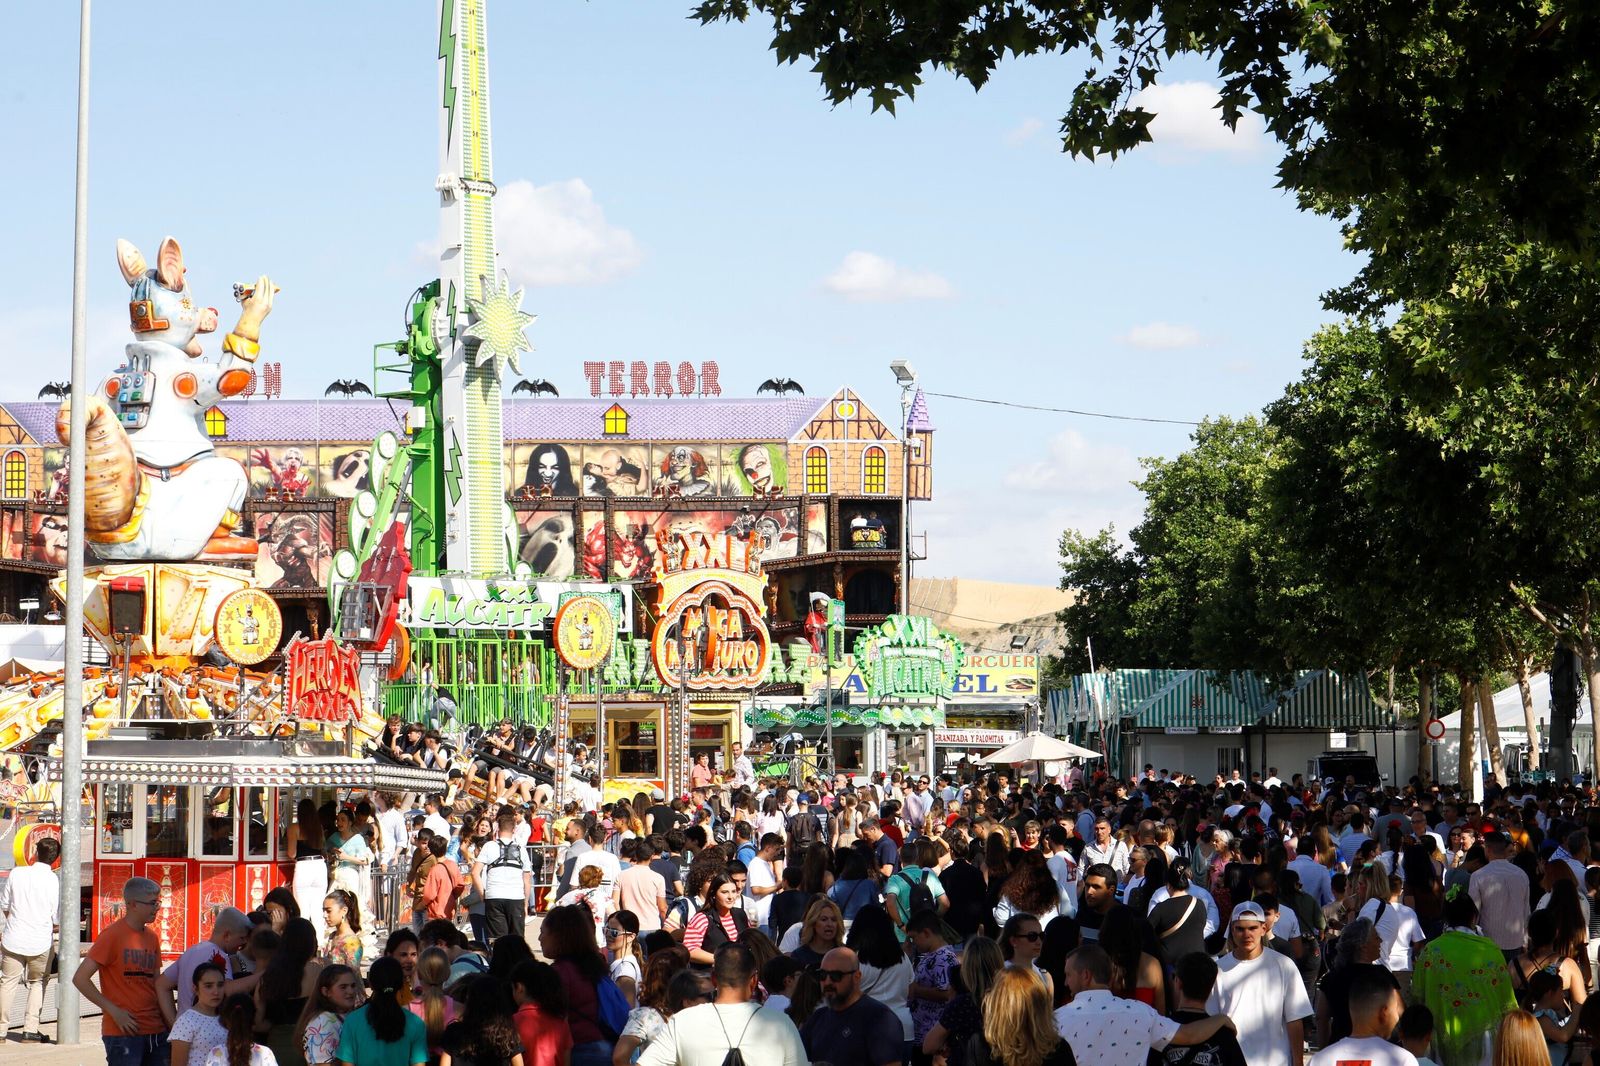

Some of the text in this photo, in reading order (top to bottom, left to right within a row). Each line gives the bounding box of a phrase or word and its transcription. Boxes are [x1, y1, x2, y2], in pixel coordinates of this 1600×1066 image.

[584, 361, 721, 398] TERROR
[680, 533, 747, 573] XXL
[419, 587, 552, 628] ALCATR
[484, 584, 539, 604] XXL
[223, 610, 235, 645] XXL
[682, 607, 743, 640] MGA
[886, 614, 935, 648] XXL
[962, 655, 1035, 668] RGUER
[289, 641, 363, 720] HEROES
[935, 733, 969, 743] GRANIZADA
[976, 735, 1004, 743] PALOMITAS
